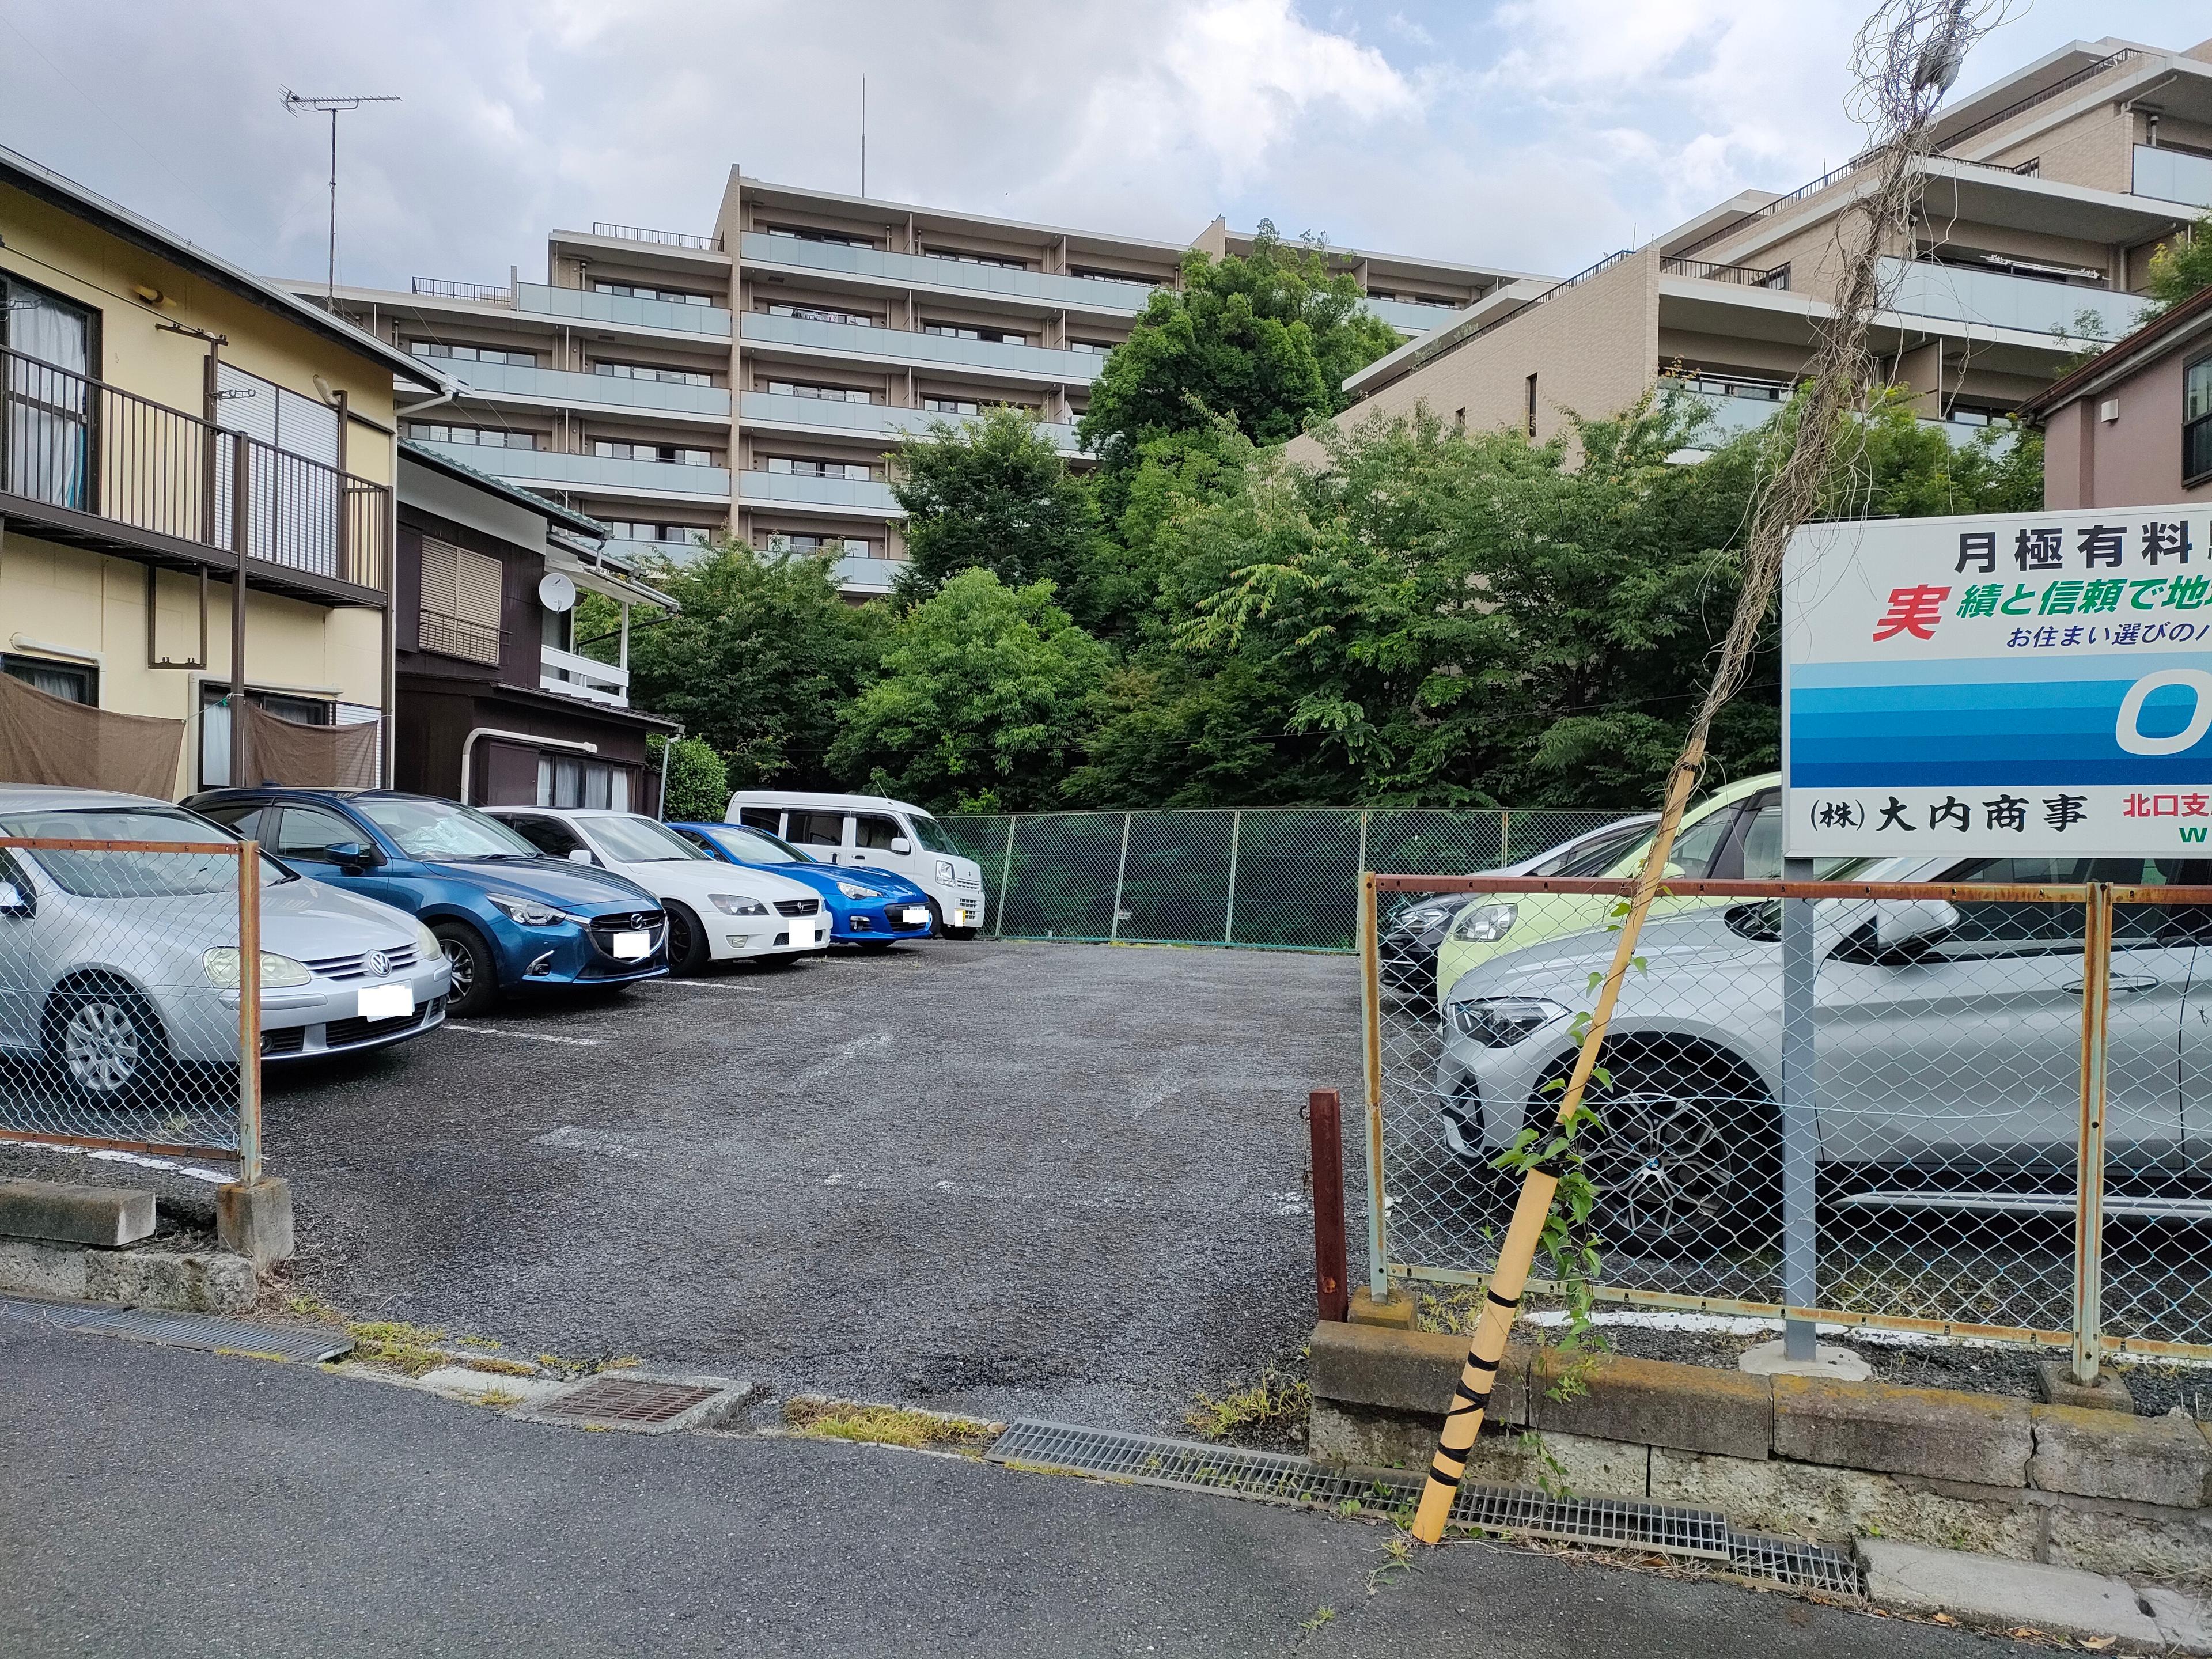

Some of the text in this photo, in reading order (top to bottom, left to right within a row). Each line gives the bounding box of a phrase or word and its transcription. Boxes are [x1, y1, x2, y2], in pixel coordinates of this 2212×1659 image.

[1955, 520, 2212, 574] 月極有料
[1873, 574, 2212, 642] 実績と信頼で地
[2123, 793, 2212, 817] 北口支
